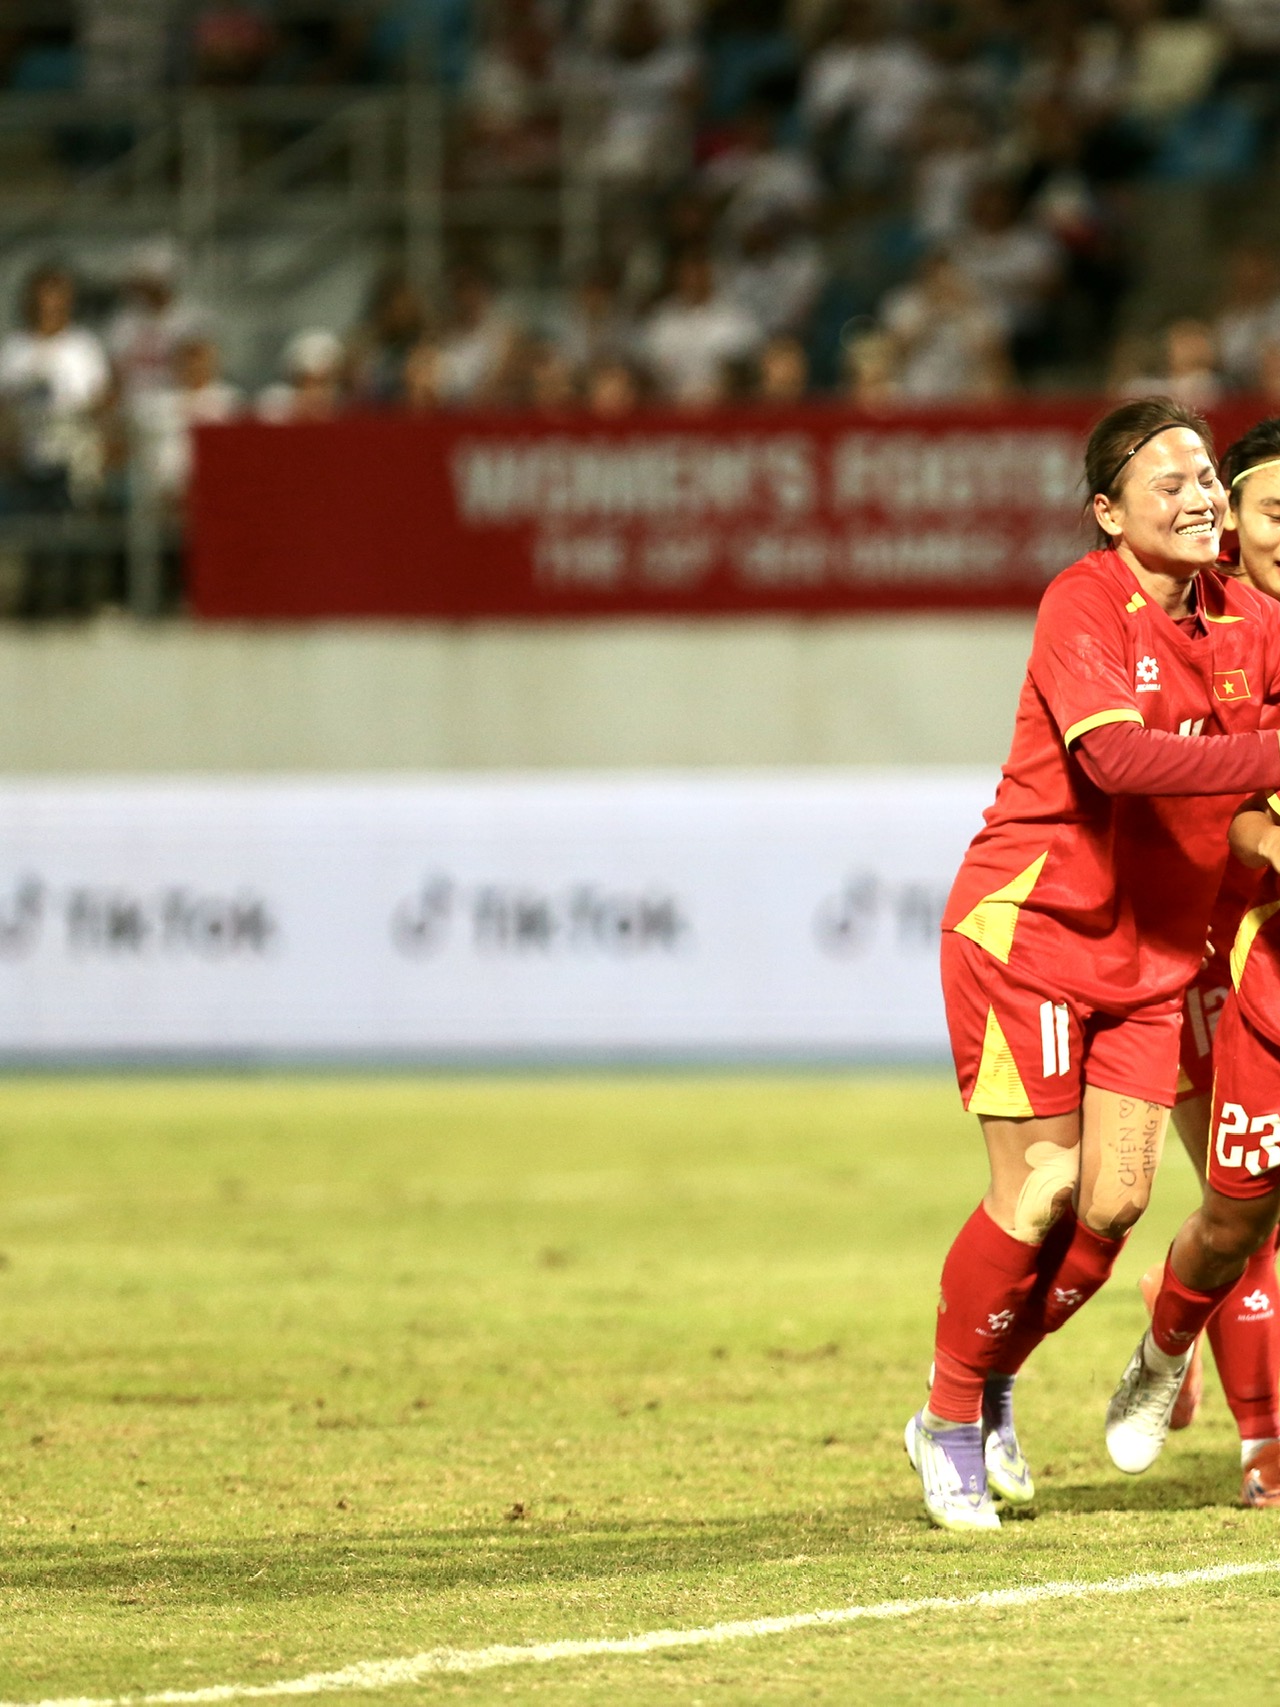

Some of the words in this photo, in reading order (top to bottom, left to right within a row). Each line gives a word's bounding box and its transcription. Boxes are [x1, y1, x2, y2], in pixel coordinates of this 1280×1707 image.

[453, 440, 812, 522] WOMEN'S
[836, 430, 1088, 512] FOOTB
[65, 884, 274, 956] TikTok
[472, 884, 682, 956] TikTok
[1039, 1000, 1071, 1079] 11
